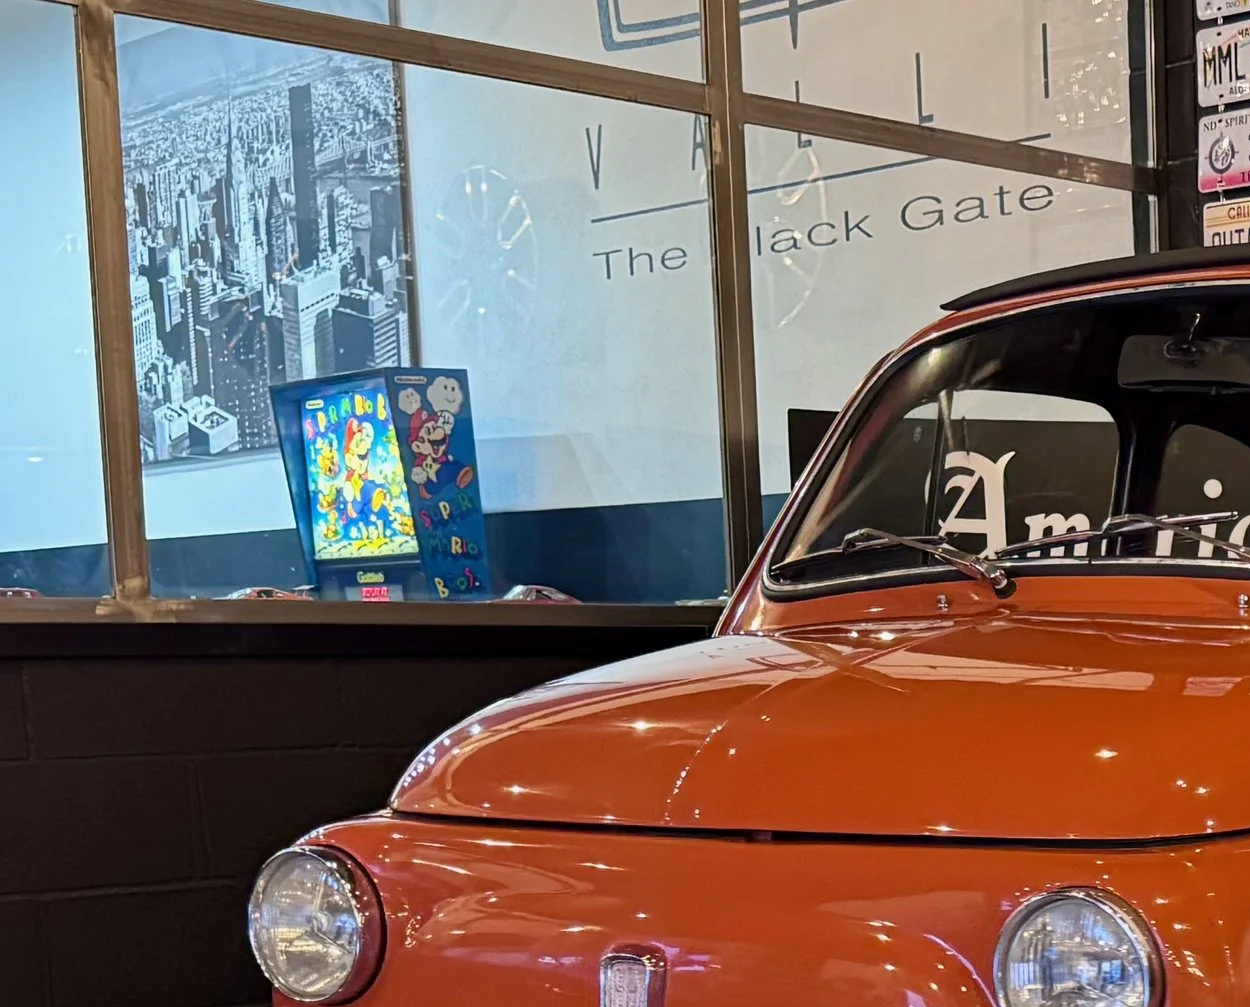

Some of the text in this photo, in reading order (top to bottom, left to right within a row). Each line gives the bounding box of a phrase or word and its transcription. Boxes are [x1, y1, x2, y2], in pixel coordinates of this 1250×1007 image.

[1203, 42, 1246, 88] MML
[1203, 121, 1217, 132] ND
[592, 183, 1055, 280] The lack Gate
[434, 567, 481, 599] BOS.
